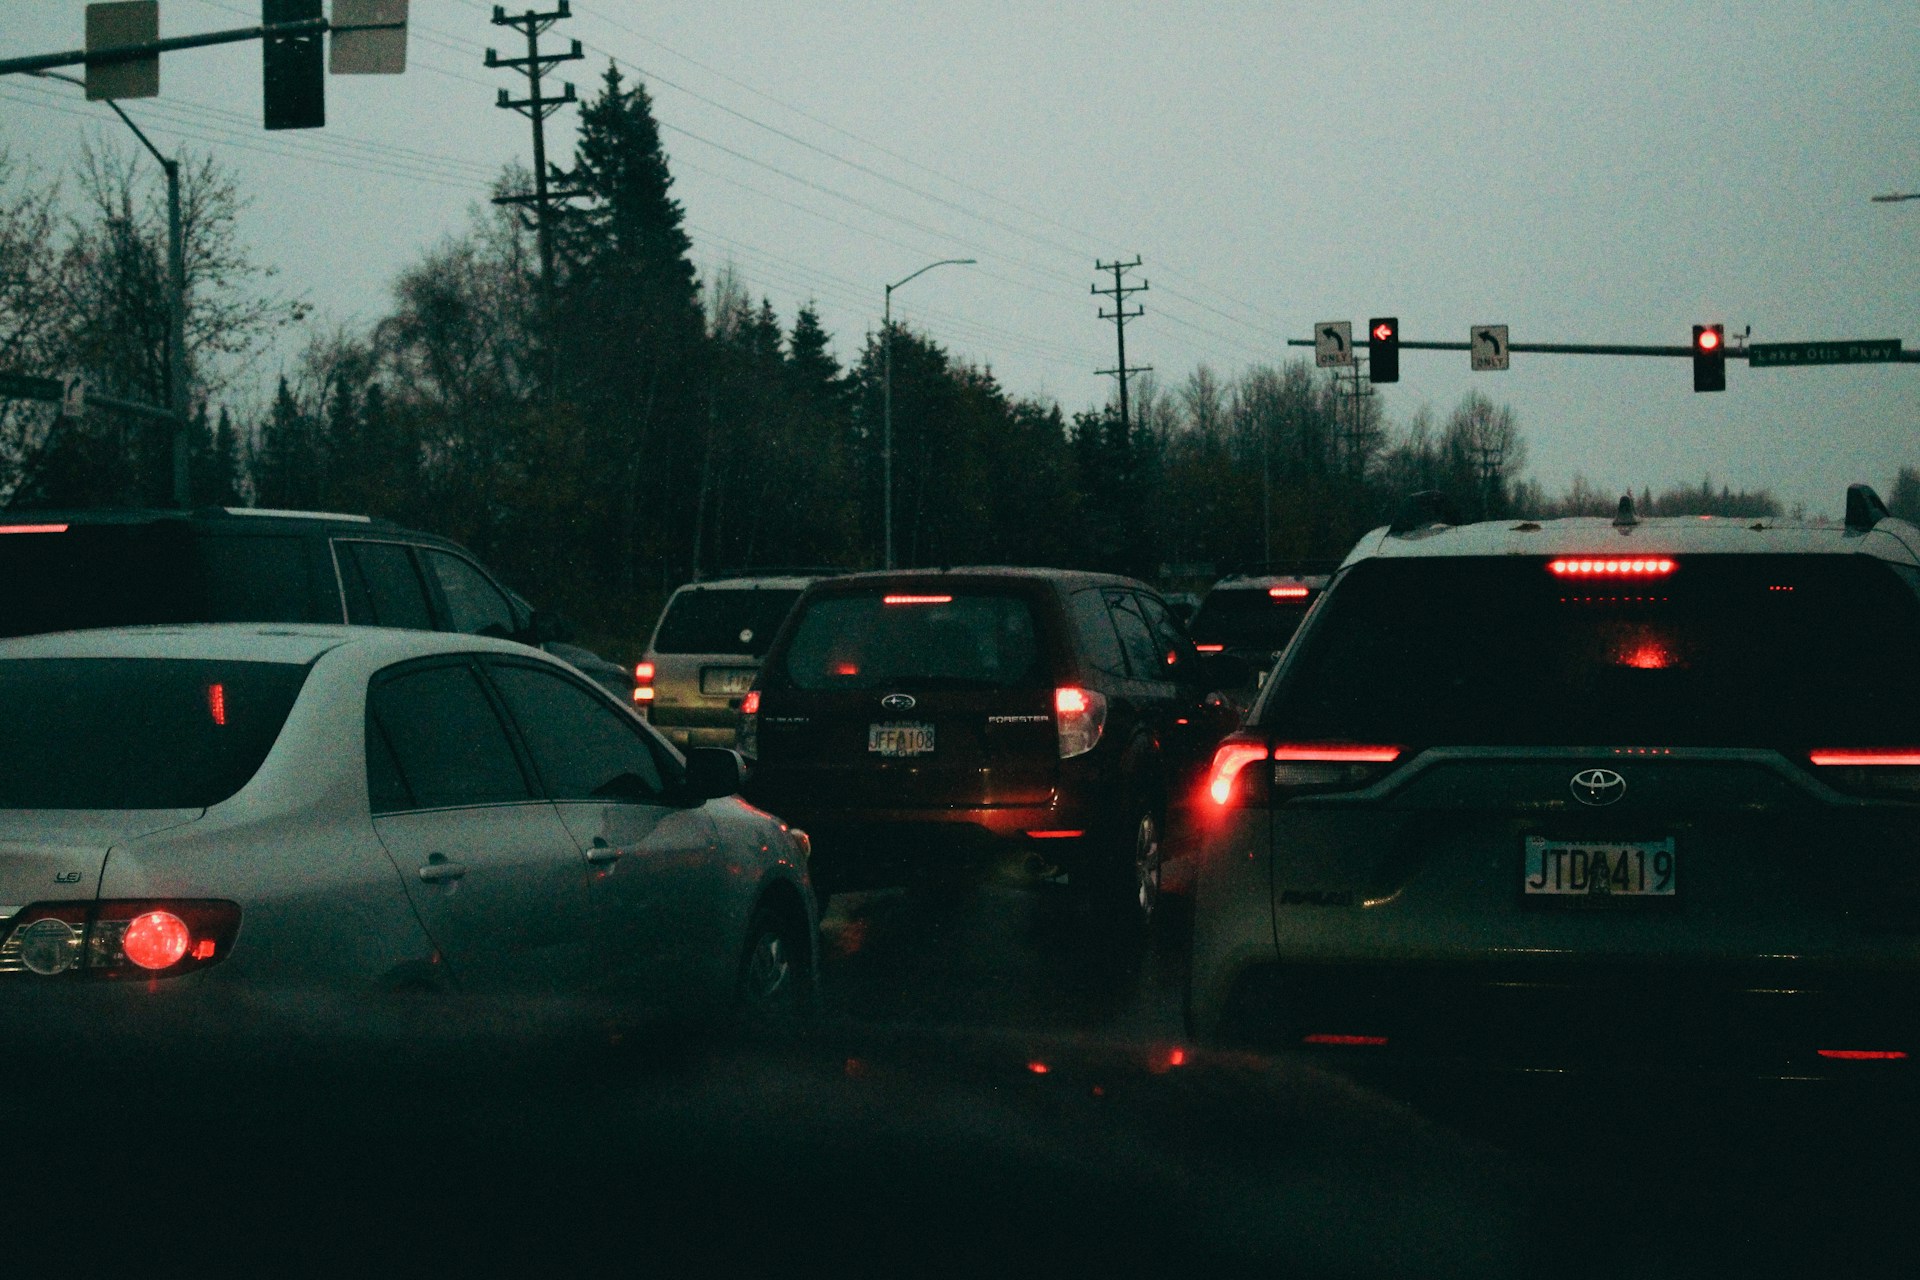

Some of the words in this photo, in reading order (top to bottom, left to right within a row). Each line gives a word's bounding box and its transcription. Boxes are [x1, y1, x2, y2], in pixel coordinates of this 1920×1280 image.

[1755, 350, 1798, 361] Lake
[1806, 348, 1840, 360] Otis
[1849, 346, 1891, 359] Pkwy
[988, 715, 1049, 723] FORESTER
